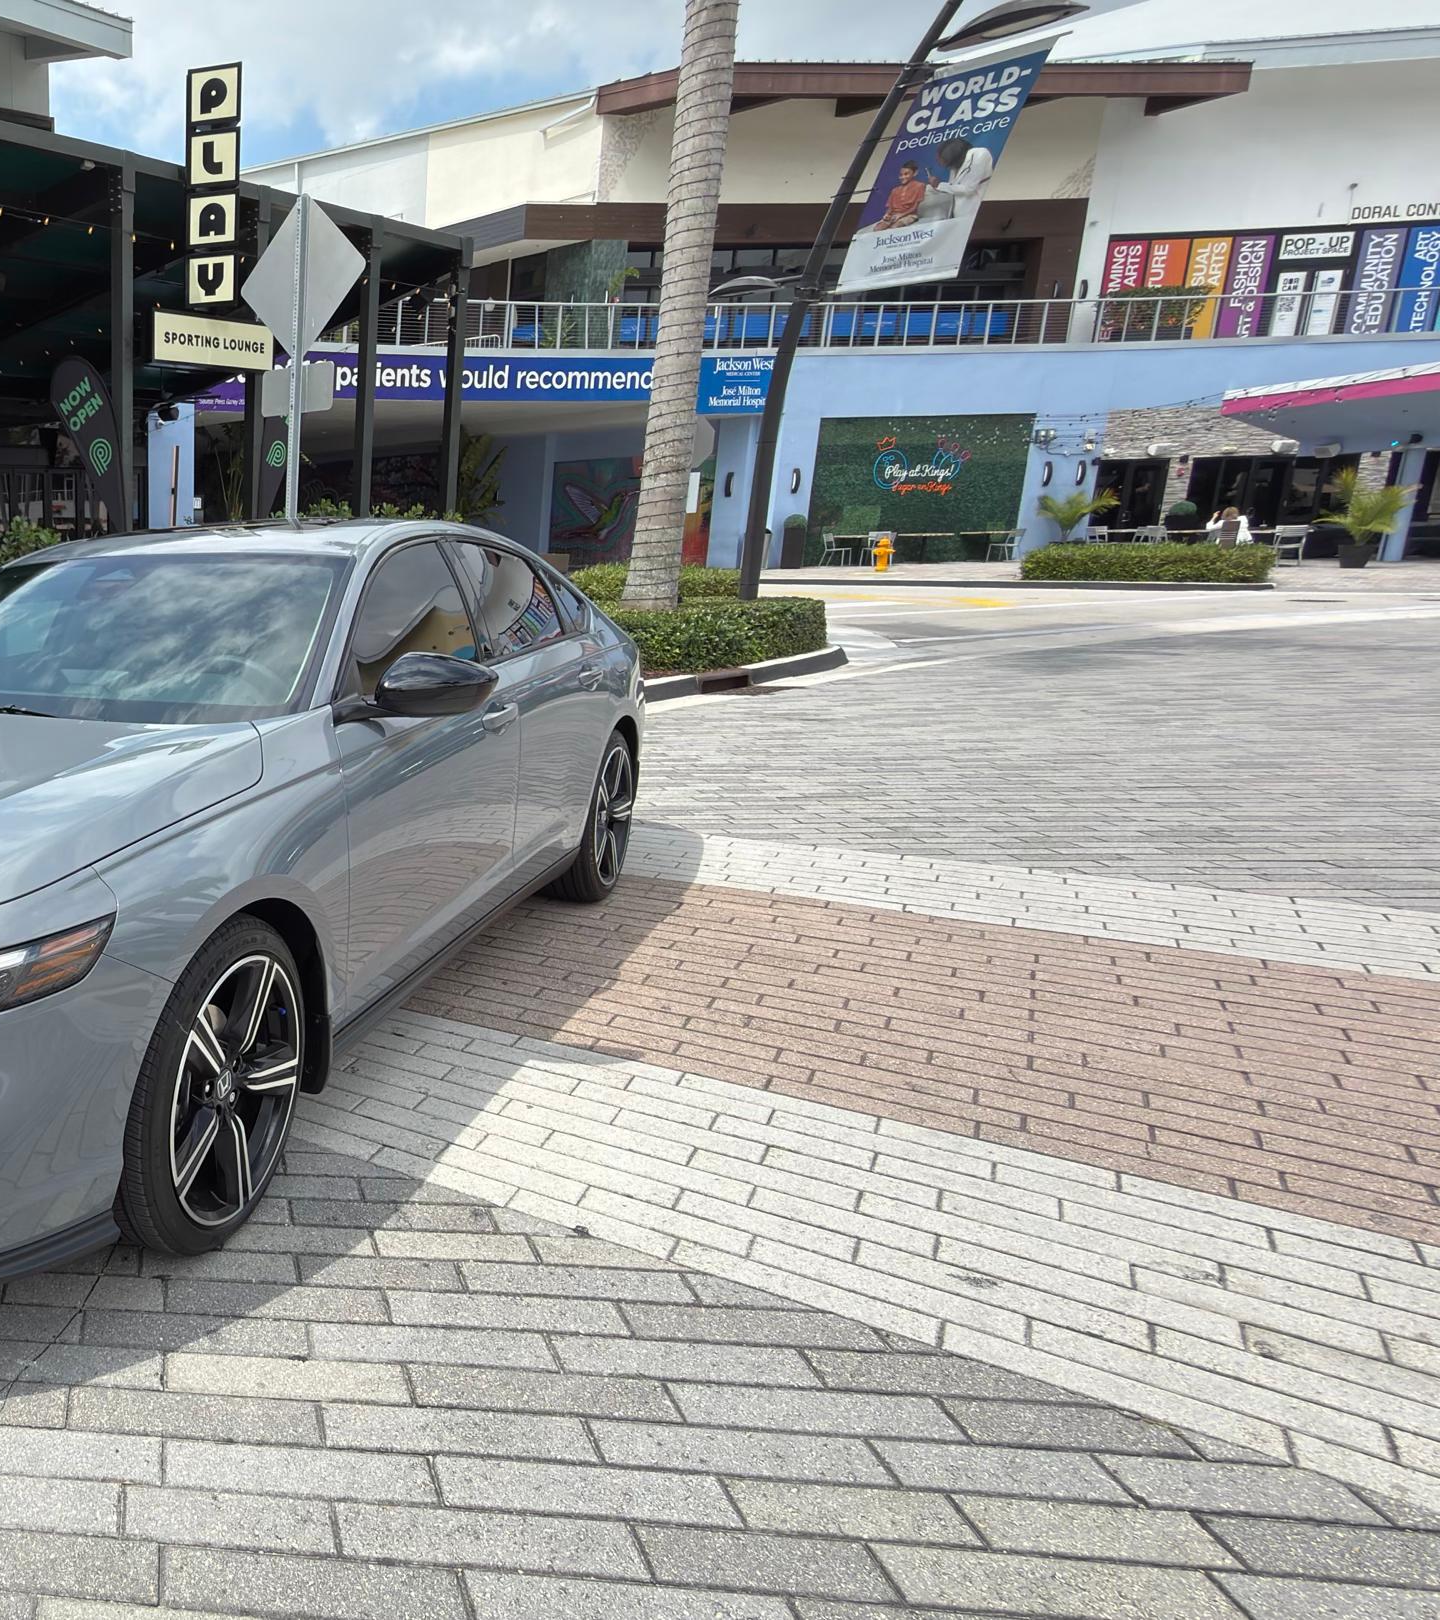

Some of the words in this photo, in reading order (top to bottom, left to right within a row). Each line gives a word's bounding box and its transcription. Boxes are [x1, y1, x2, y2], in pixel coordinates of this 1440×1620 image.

[921, 66, 1033, 107] WORLD-
[906, 87, 1022, 133] CLASS
[895, 125, 970, 154] pediatric
[972, 115, 1011, 134] care
[197, 78, 227, 296] PLAY
[1351, 205, 1401, 220] DORAL
[873, 231, 911, 249] Jackson
[912, 229, 934, 240] West
[1284, 238, 1316, 250] POP
[1328, 236, 1350, 248] UP
[1321, 246, 1349, 254] SPACE
[1414, 232, 1430, 260] ART
[1123, 244, 1142, 287] ARTS
[1148, 244, 1169, 288] TURE
[1191, 242, 1212, 287] SUAL
[1207, 241, 1227, 286] ARTS
[1230, 240, 1254, 307] FASHION
[1244, 239, 1268, 296] DESIGN
[1366, 233, 1399, 325] EDUCATION
[1409, 231, 1440, 330] TECHNOLOGY
[1351, 234, 1384, 334] COMMUNITY
[164, 332, 220, 349] SPORTING
[223, 338, 265, 354] LOUNGE
[336, 362, 431, 391] paients
[713, 358, 751, 374] Jackson
[753, 357, 774, 370] West
[60, 376, 91, 415] NOW
[708, 396, 741, 406] Memorial
[742, 396, 766, 408] Hospit
[737, 386, 761, 395] Milton
[70, 393, 103, 431] OPEN
[885, 464, 907, 481] Play
[908, 464, 921, 477] at
[921, 464, 954, 482] Kings!
